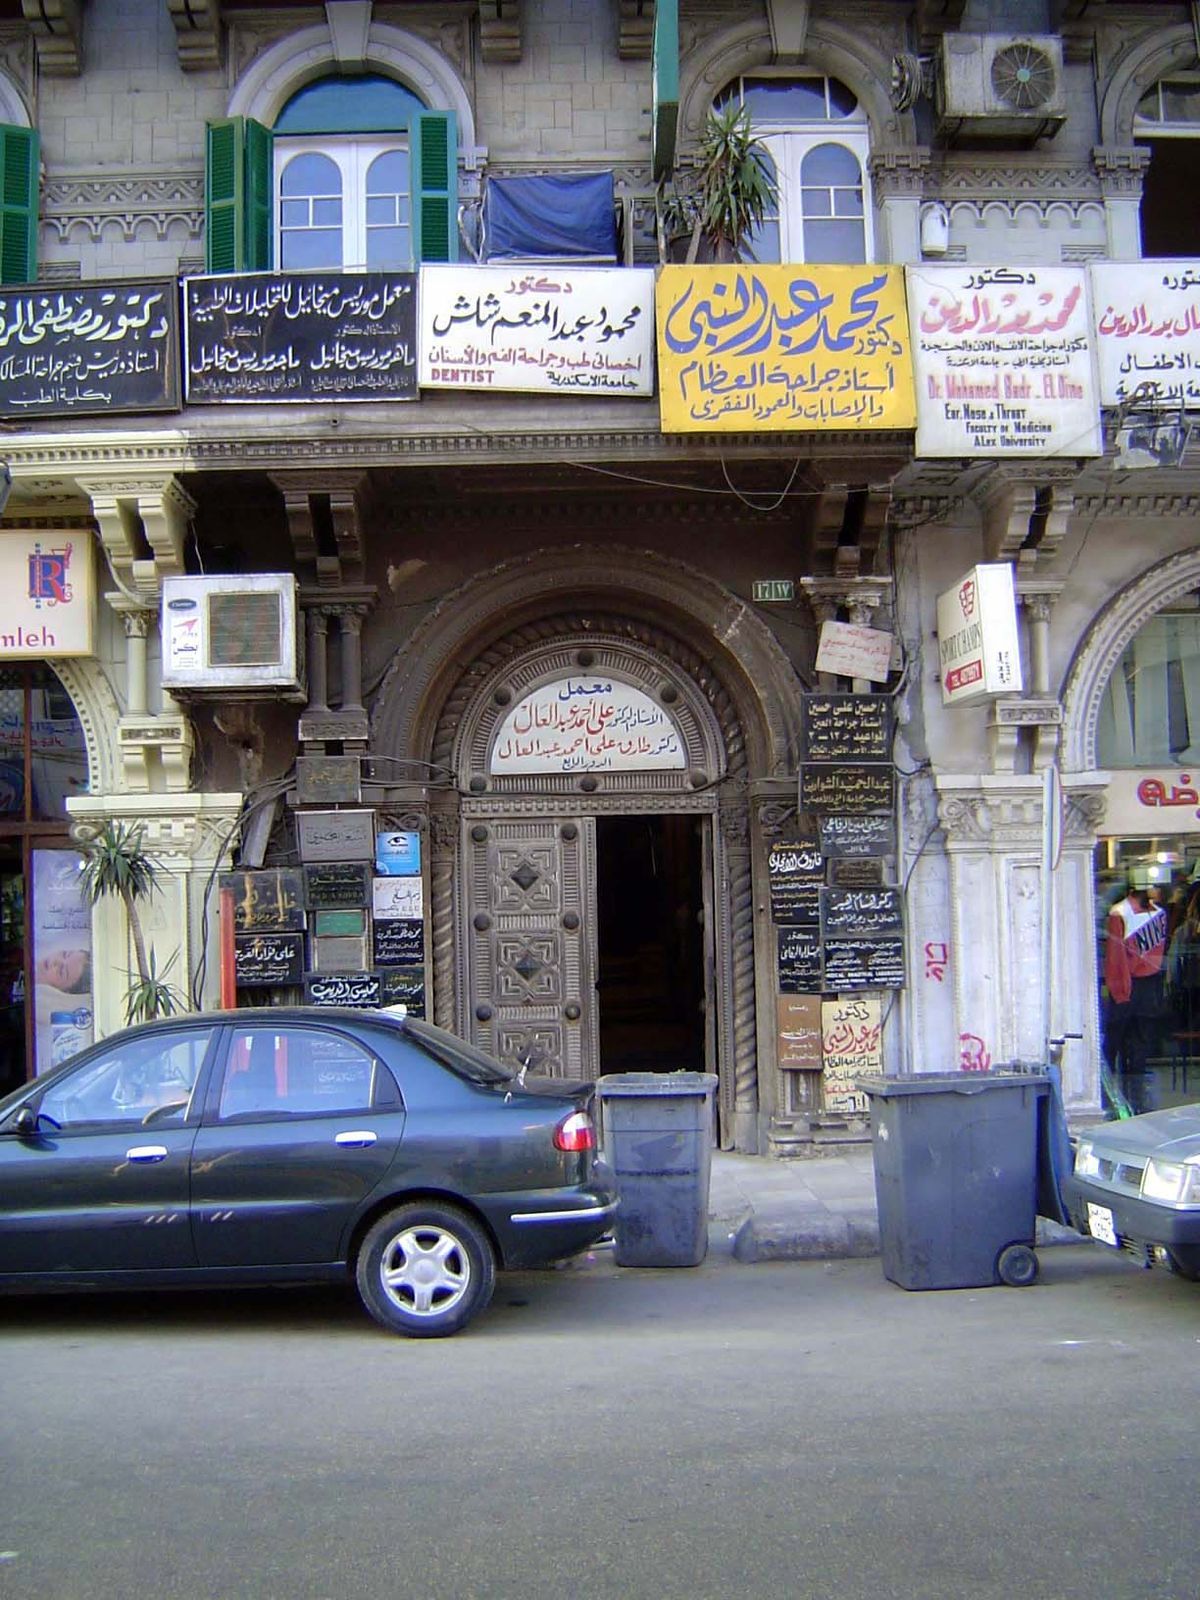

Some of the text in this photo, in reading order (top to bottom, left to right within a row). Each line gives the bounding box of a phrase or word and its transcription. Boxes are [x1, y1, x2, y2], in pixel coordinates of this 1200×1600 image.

[505, 275, 573, 295] دكتور
[962, 268, 1036, 290] دكتور
[1162, 270, 1200, 290] توره
[192, 286, 232, 322] الطبية
[285, 285, 339, 319] ميخائيل
[327, 285, 379, 317] موريس
[368, 284, 410, 319] معمل
[18, 294, 104, 345] مصطفى
[86, 293, 169, 341] دكتور
[491, 300, 559, 345] المنعم
[596, 306, 641, 343] محمود
[733, 278, 834, 356] عبد
[778, 272, 889, 356] محمد
[1099, 303, 1147, 337] الدين
[549, 314, 594, 342] عبد
[853, 314, 903, 356] دكتور
[1138, 318, 1174, 339] بدر
[488, 347, 517, 365] الفم
[518, 348, 566, 368] وجراحة
[567, 352, 591, 369] طب
[1120, 352, 1191, 373] الاطفال
[431, 368, 495, 384] DENTIST
[546, 370, 639, 389] جامعة الاسكندرية
[679, 360, 895, 400] أستاذ جراحة العظام
[9, 385, 112, 407] بكلية الطب
[755, 393, 803, 420] والعمود
[963, 404, 987, 420] Nose
[1014, 422, 1052, 433] Medicine
[757, 583, 770, 599] 17
[776, 583, 790, 598] ١٧
[558, 681, 612, 701] معمل
[513, 702, 559, 734] العال
[555, 704, 580, 732] عبد
[808, 700, 831, 716] حسين
[833, 700, 853, 715] على
[586, 702, 614, 735] على
[812, 718, 832, 729] العين
[834, 717, 858, 729] جراحة
[498, 738, 541, 759] العال
[540, 743, 566, 759] عبد
[589, 735, 616, 756] على
[618, 736, 650, 755] طارق
[648, 733, 677, 755] دكتور
[562, 756, 612, 771] الدور الرابع
[1136, 912, 1168, 954] NIKE
[351, 982, 379, 998] خميس
[832, 1001, 870, 1021] دكتور
[844, 1025, 871, 1054] عبد
[855, 1023, 882, 1054] محمد
